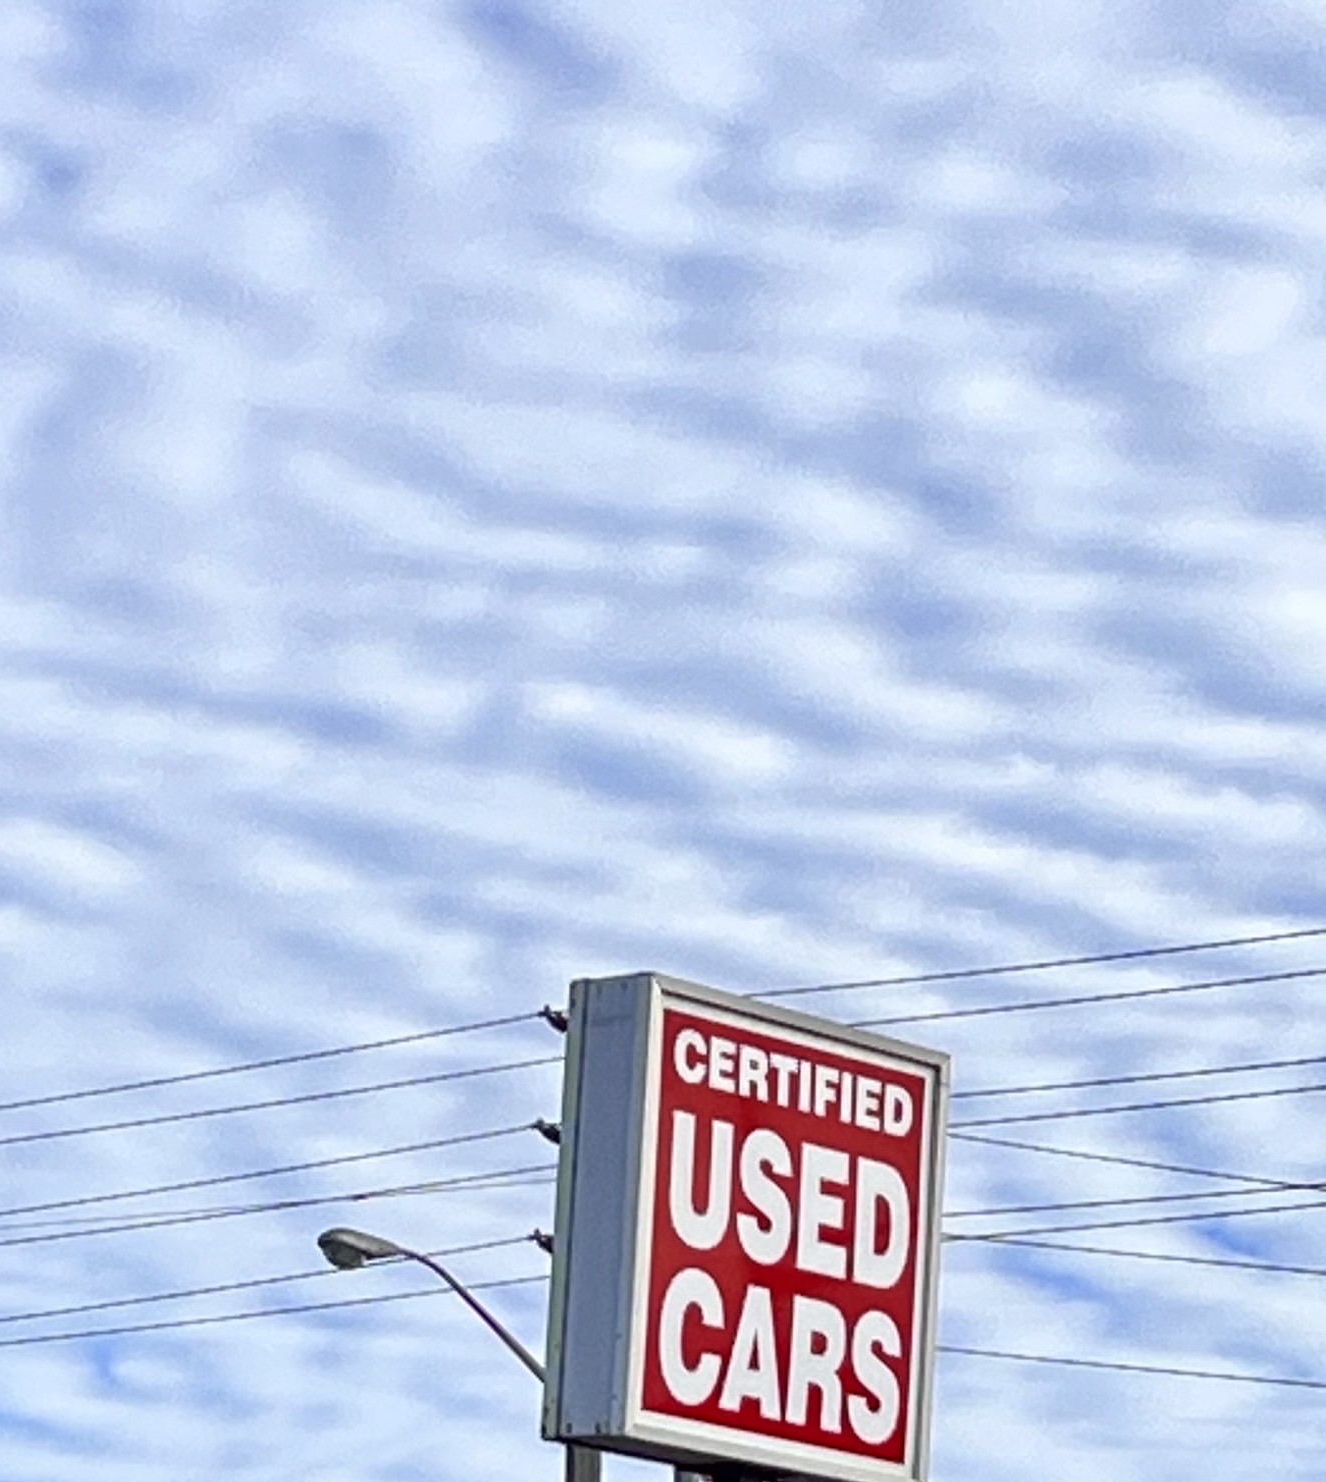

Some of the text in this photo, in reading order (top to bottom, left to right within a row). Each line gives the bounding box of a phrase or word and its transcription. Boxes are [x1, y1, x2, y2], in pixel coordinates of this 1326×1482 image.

[674, 1029, 914, 1137] CERTIFIED
[670, 1110, 911, 1290] USED
[658, 1267, 903, 1445] CARS
